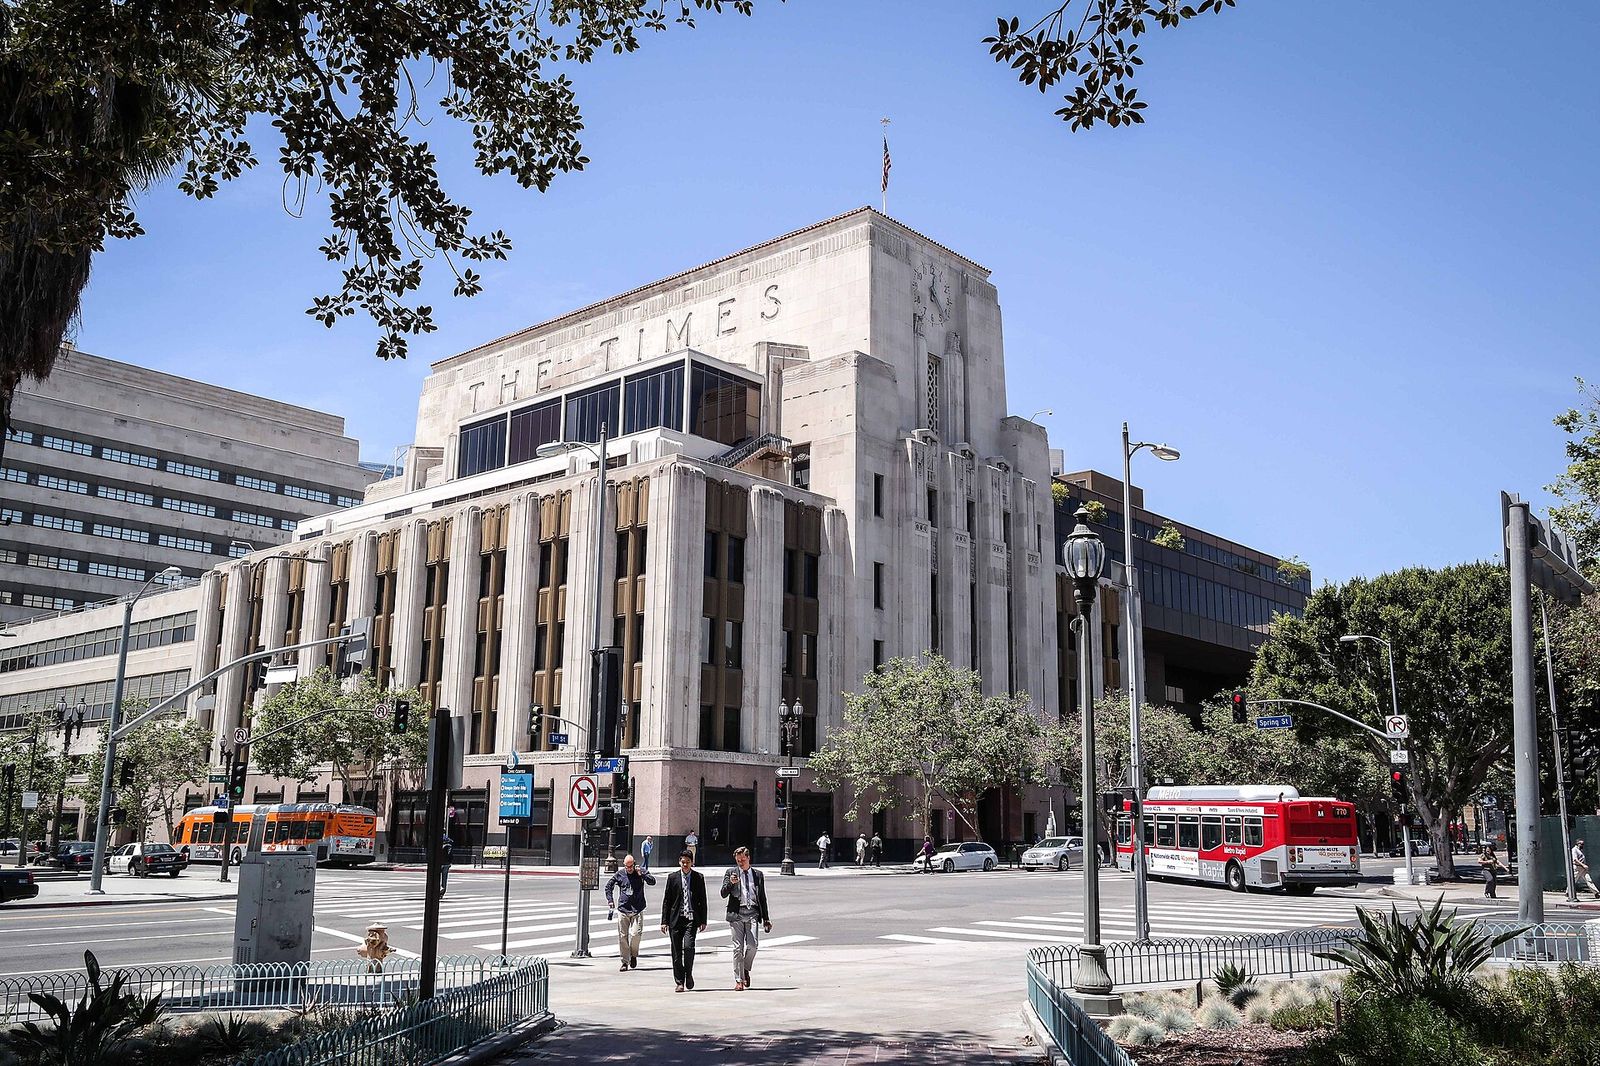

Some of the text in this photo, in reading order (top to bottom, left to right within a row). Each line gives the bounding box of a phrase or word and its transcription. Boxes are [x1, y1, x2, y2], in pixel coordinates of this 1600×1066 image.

[468, 284, 782, 413] THE TIMES
[1259, 717, 1289, 728] Spring St
[594, 759, 611, 769] Spring
[1158, 789, 1181, 800] Metro
[1335, 808, 1348, 816] 770
[1223, 846, 1247, 856] Metro Rapid
[1202, 862, 1225, 880] Rapid
